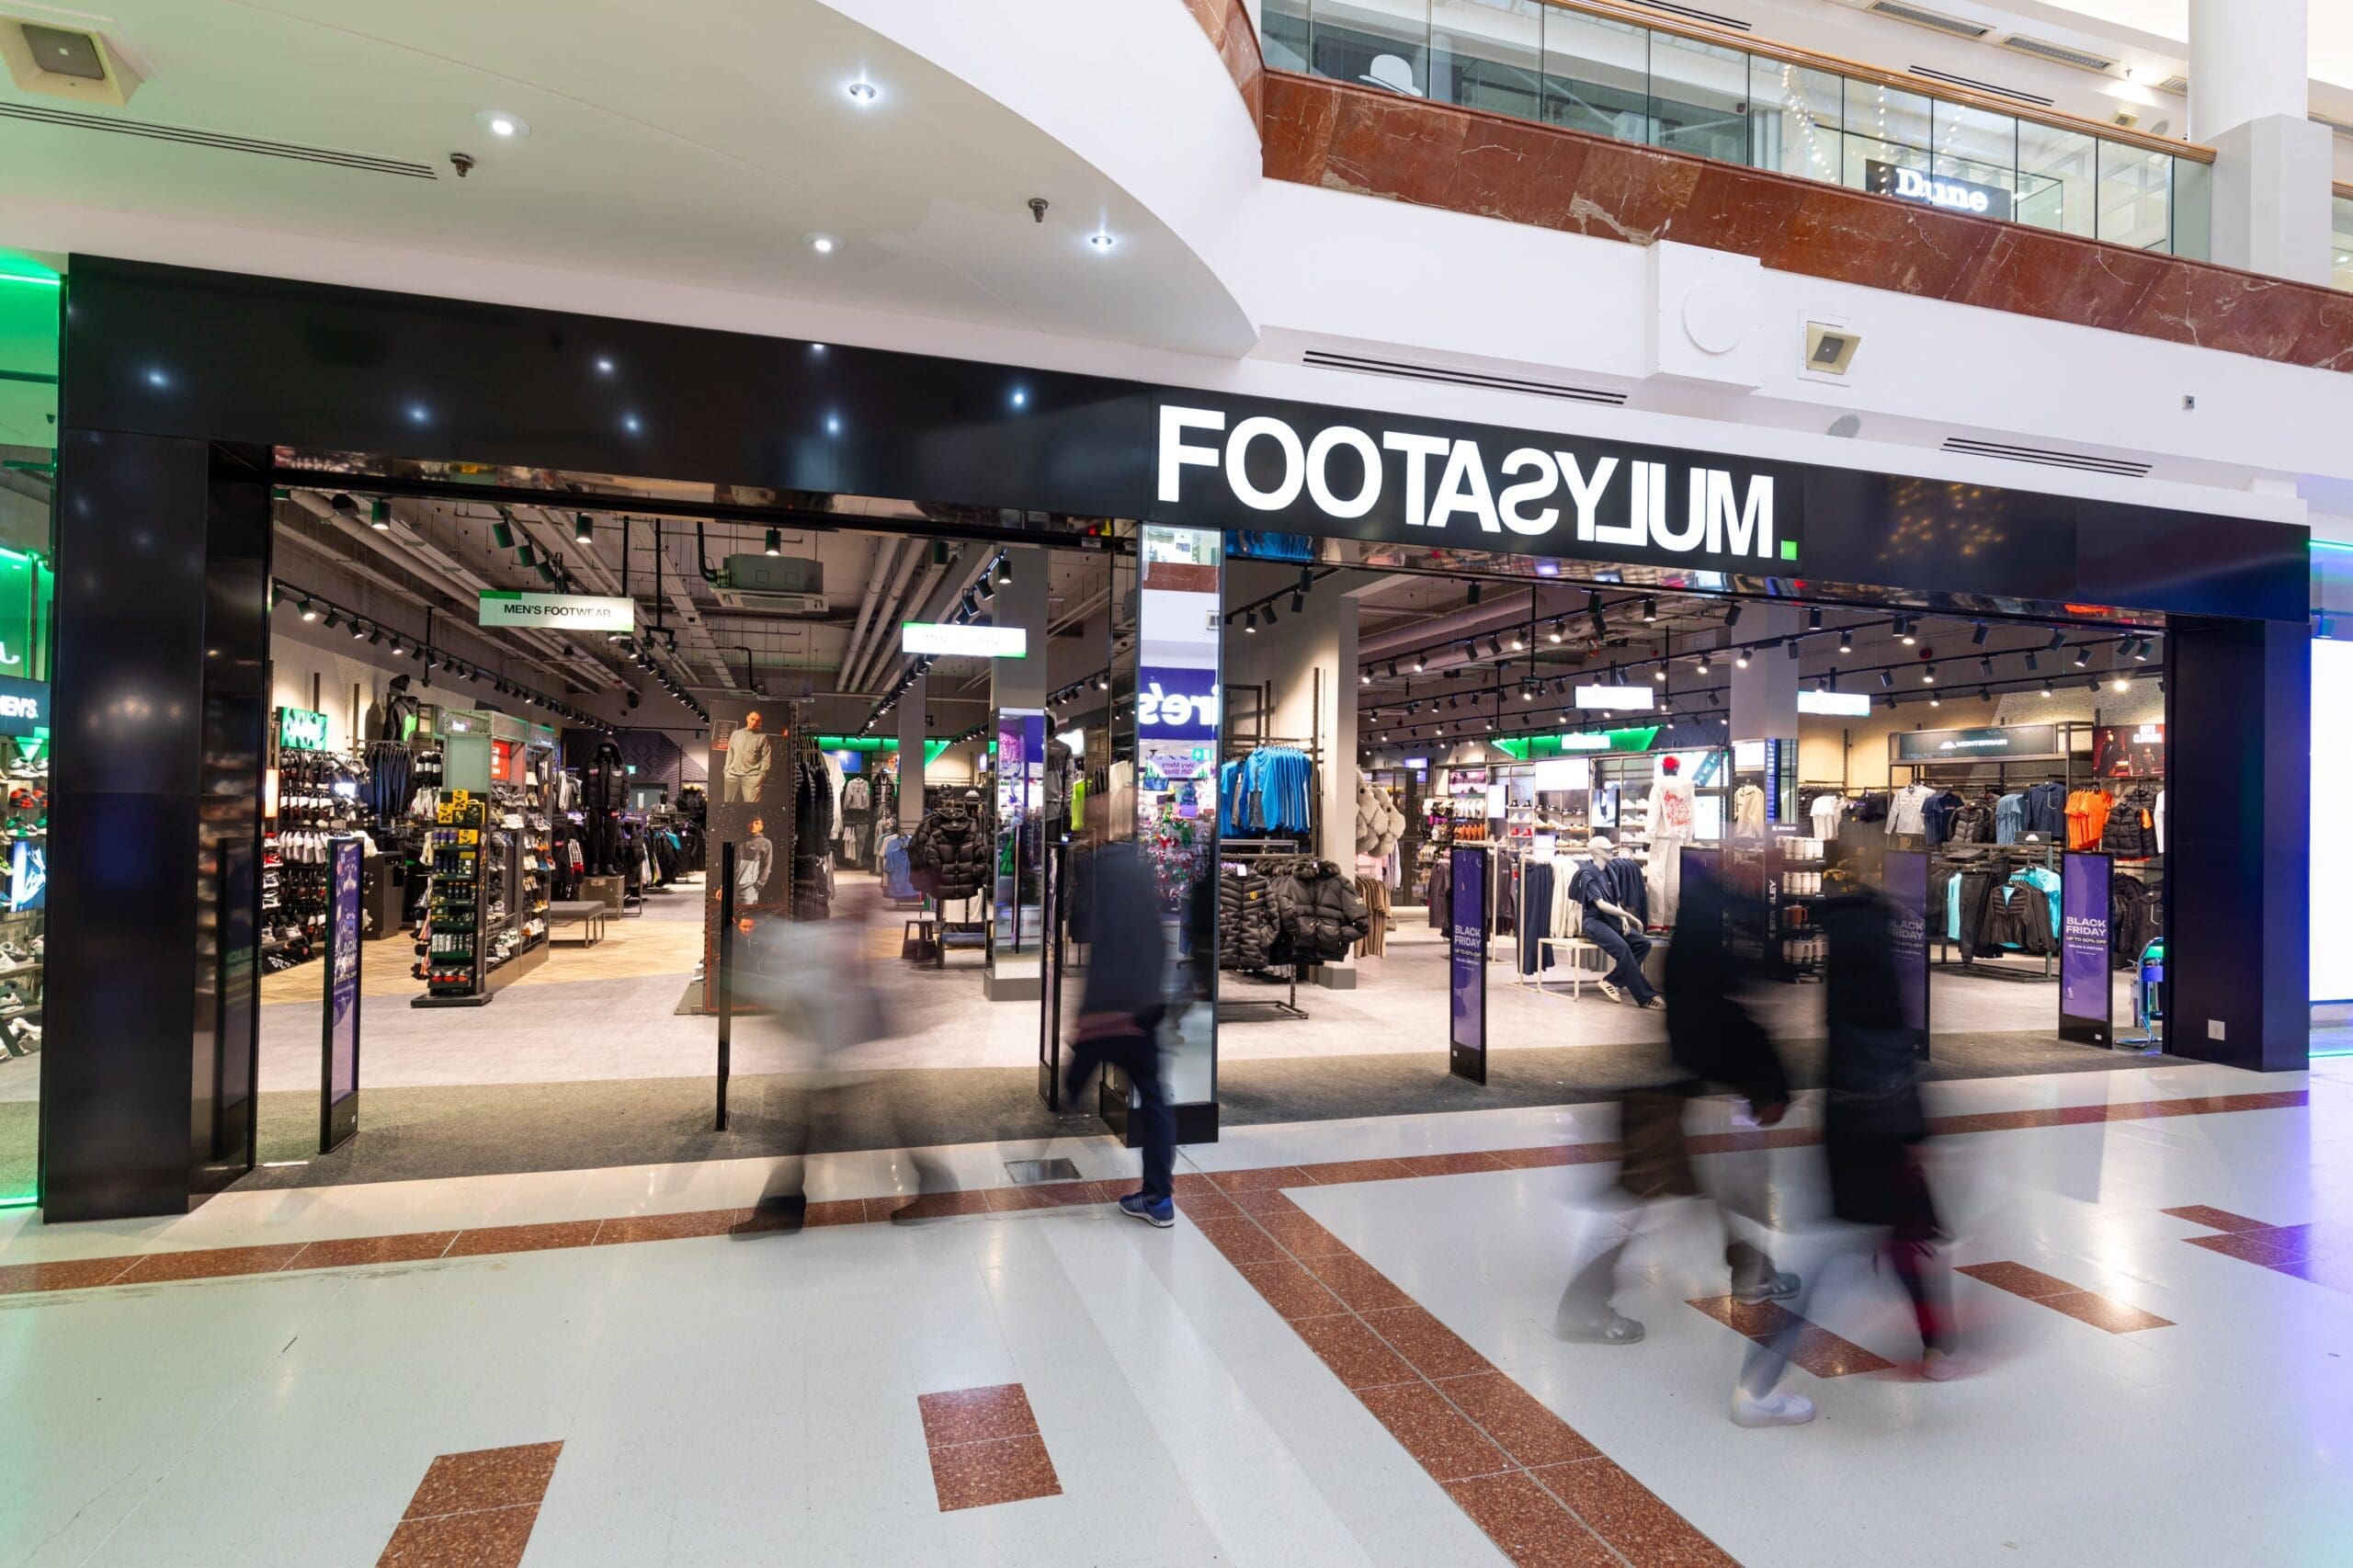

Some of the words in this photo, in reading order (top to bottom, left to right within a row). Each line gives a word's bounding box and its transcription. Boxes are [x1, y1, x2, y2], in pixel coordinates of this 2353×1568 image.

[1894, 167, 1988, 212] Dune
[504, 604, 541, 615] MEN'S
[544, 606, 611, 619] FOOTWEAR
[1890, 919, 1924, 931] LACK
[2066, 916, 2106, 927] BLACK
[1454, 925, 1481, 937] BLACK
[2066, 926, 2107, 937] FRIDAY
[1455, 936, 1481, 948] FRIDAY
